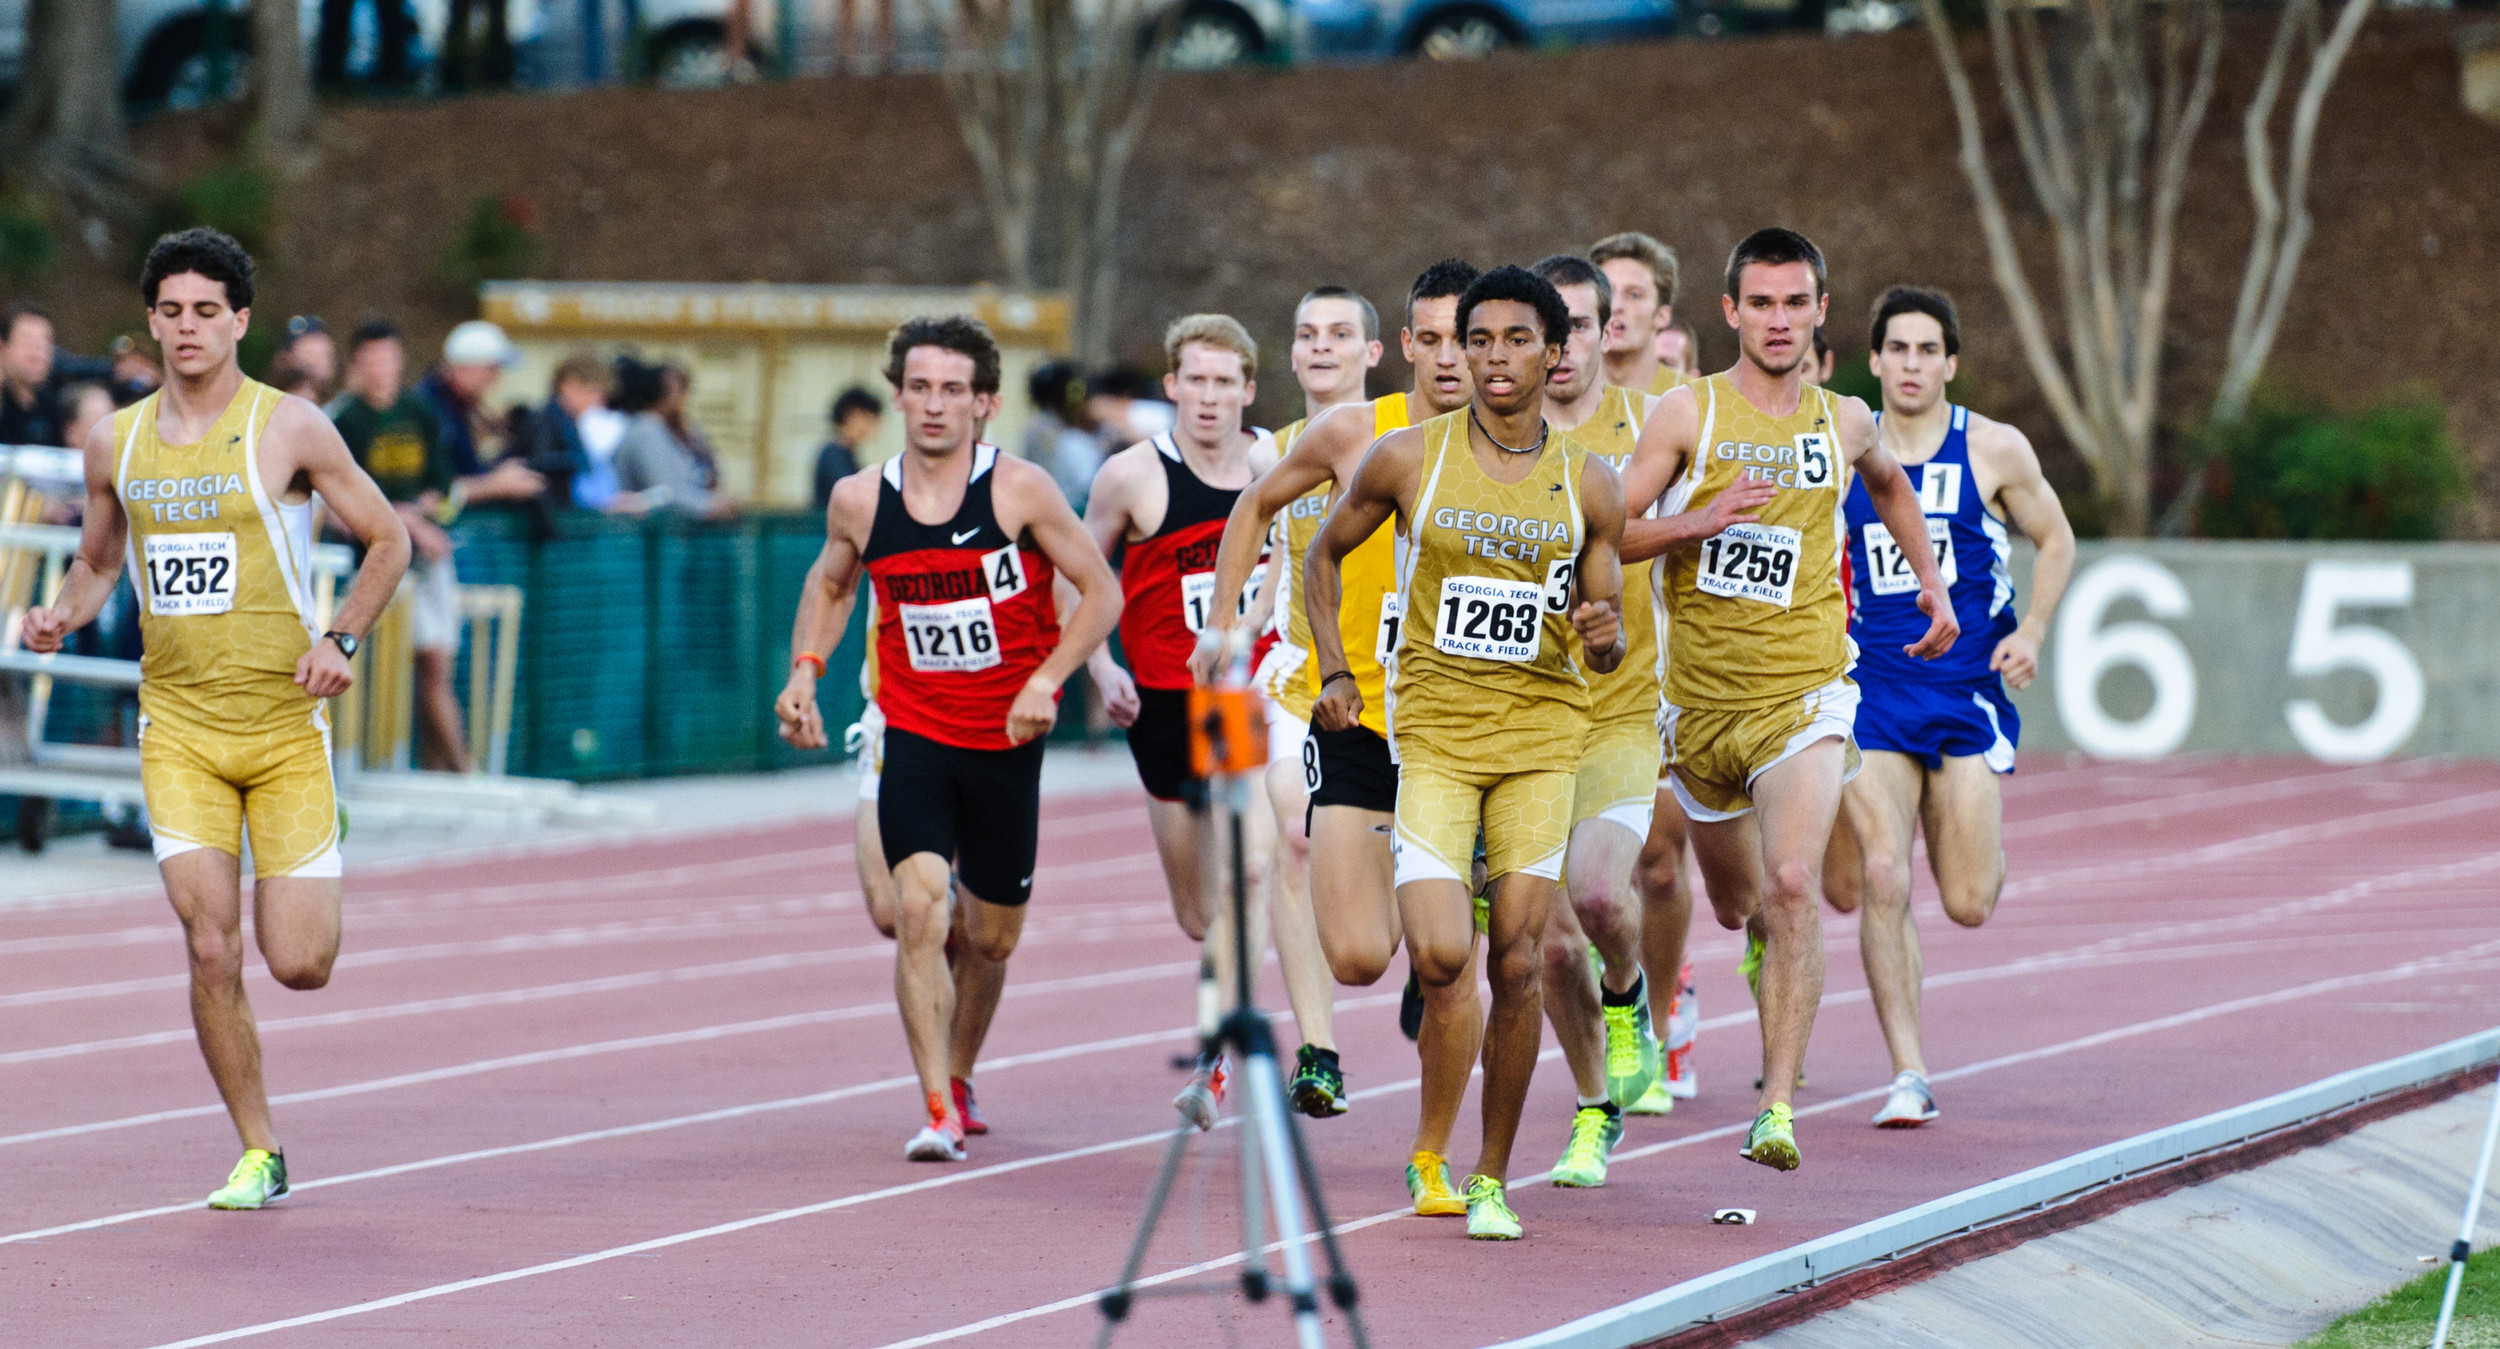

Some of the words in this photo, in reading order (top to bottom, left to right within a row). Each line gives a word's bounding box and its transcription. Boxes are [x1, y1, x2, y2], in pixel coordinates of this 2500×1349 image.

[1802, 438, 1828, 484] 5
[127, 473, 245, 501] GEORGIA
[1930, 468, 1947, 507] 1
[149, 498, 218, 523] TECH
[1433, 507, 1570, 543] GEORGIA
[199, 542, 226, 552] TECH
[1463, 534, 1541, 564] TECH
[1768, 534, 1795, 546] TECH
[1870, 539, 1948, 577] 127
[147, 556, 229, 596] 1252
[994, 552, 1019, 591] 4
[1707, 538, 1793, 588] 1259
[885, 566, 990, 602] GEORGIA
[1448, 582, 1505, 599] GEORGIA
[1509, 589, 1538, 600] TECH
[1547, 563, 1573, 612] 3
[1702, 577, 1737, 592] TRACK
[1741, 585, 1750, 593] &
[1753, 586, 1783, 600] FIELD
[196, 598, 225, 608] FIELD
[1444, 596, 1538, 643] 1263
[908, 620, 992, 657] 1216
[1442, 638, 1480, 653] TRACK
[1485, 644, 1494, 653] &
[1498, 645, 1529, 656] FIELD
[2054, 553, 2197, 760] 6
[2284, 558, 2426, 764] 5
[1303, 740, 1318, 788] 8
